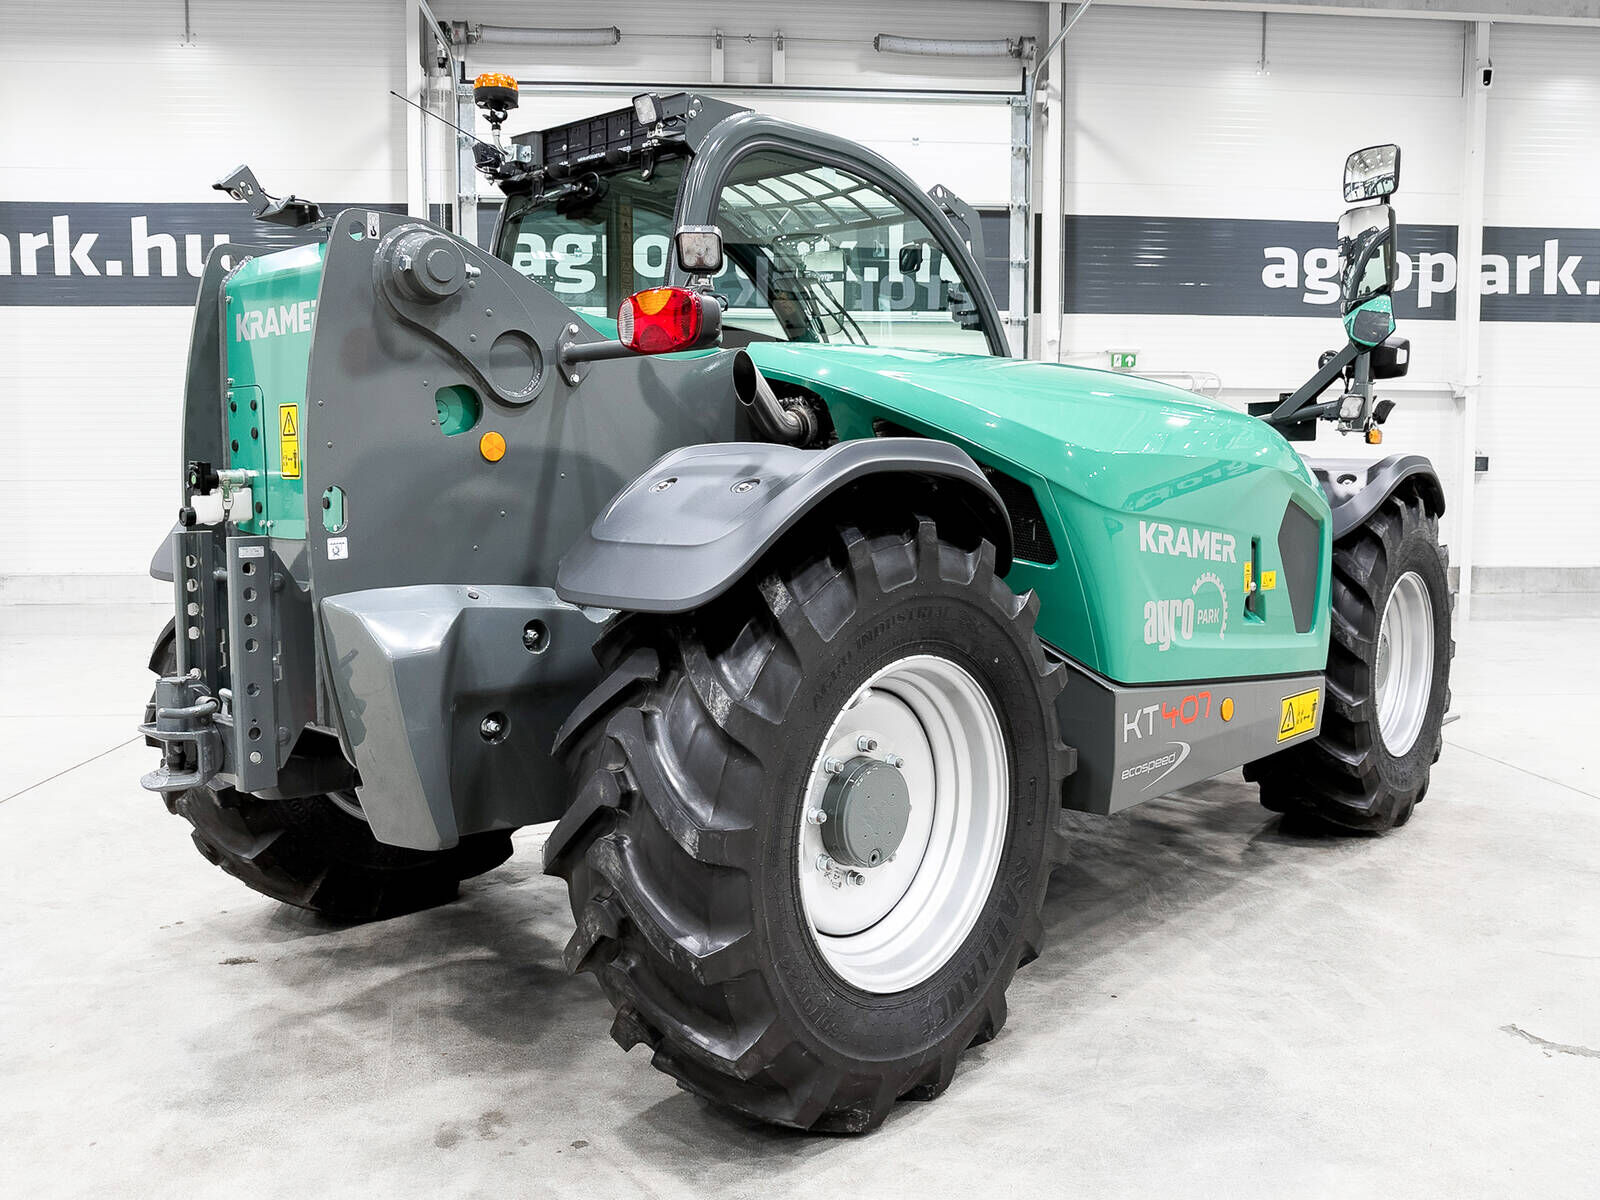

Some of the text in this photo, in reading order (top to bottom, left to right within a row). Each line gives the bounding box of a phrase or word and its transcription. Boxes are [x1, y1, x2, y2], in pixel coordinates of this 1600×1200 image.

[0, 215, 231, 277] rk.hu
[1261, 238, 1600, 308] agpark.
[1139, 520, 1236, 563] KRAMER
[1143, 598, 1220, 652] agro PARK
[1121, 751, 1177, 781] ecospeed
